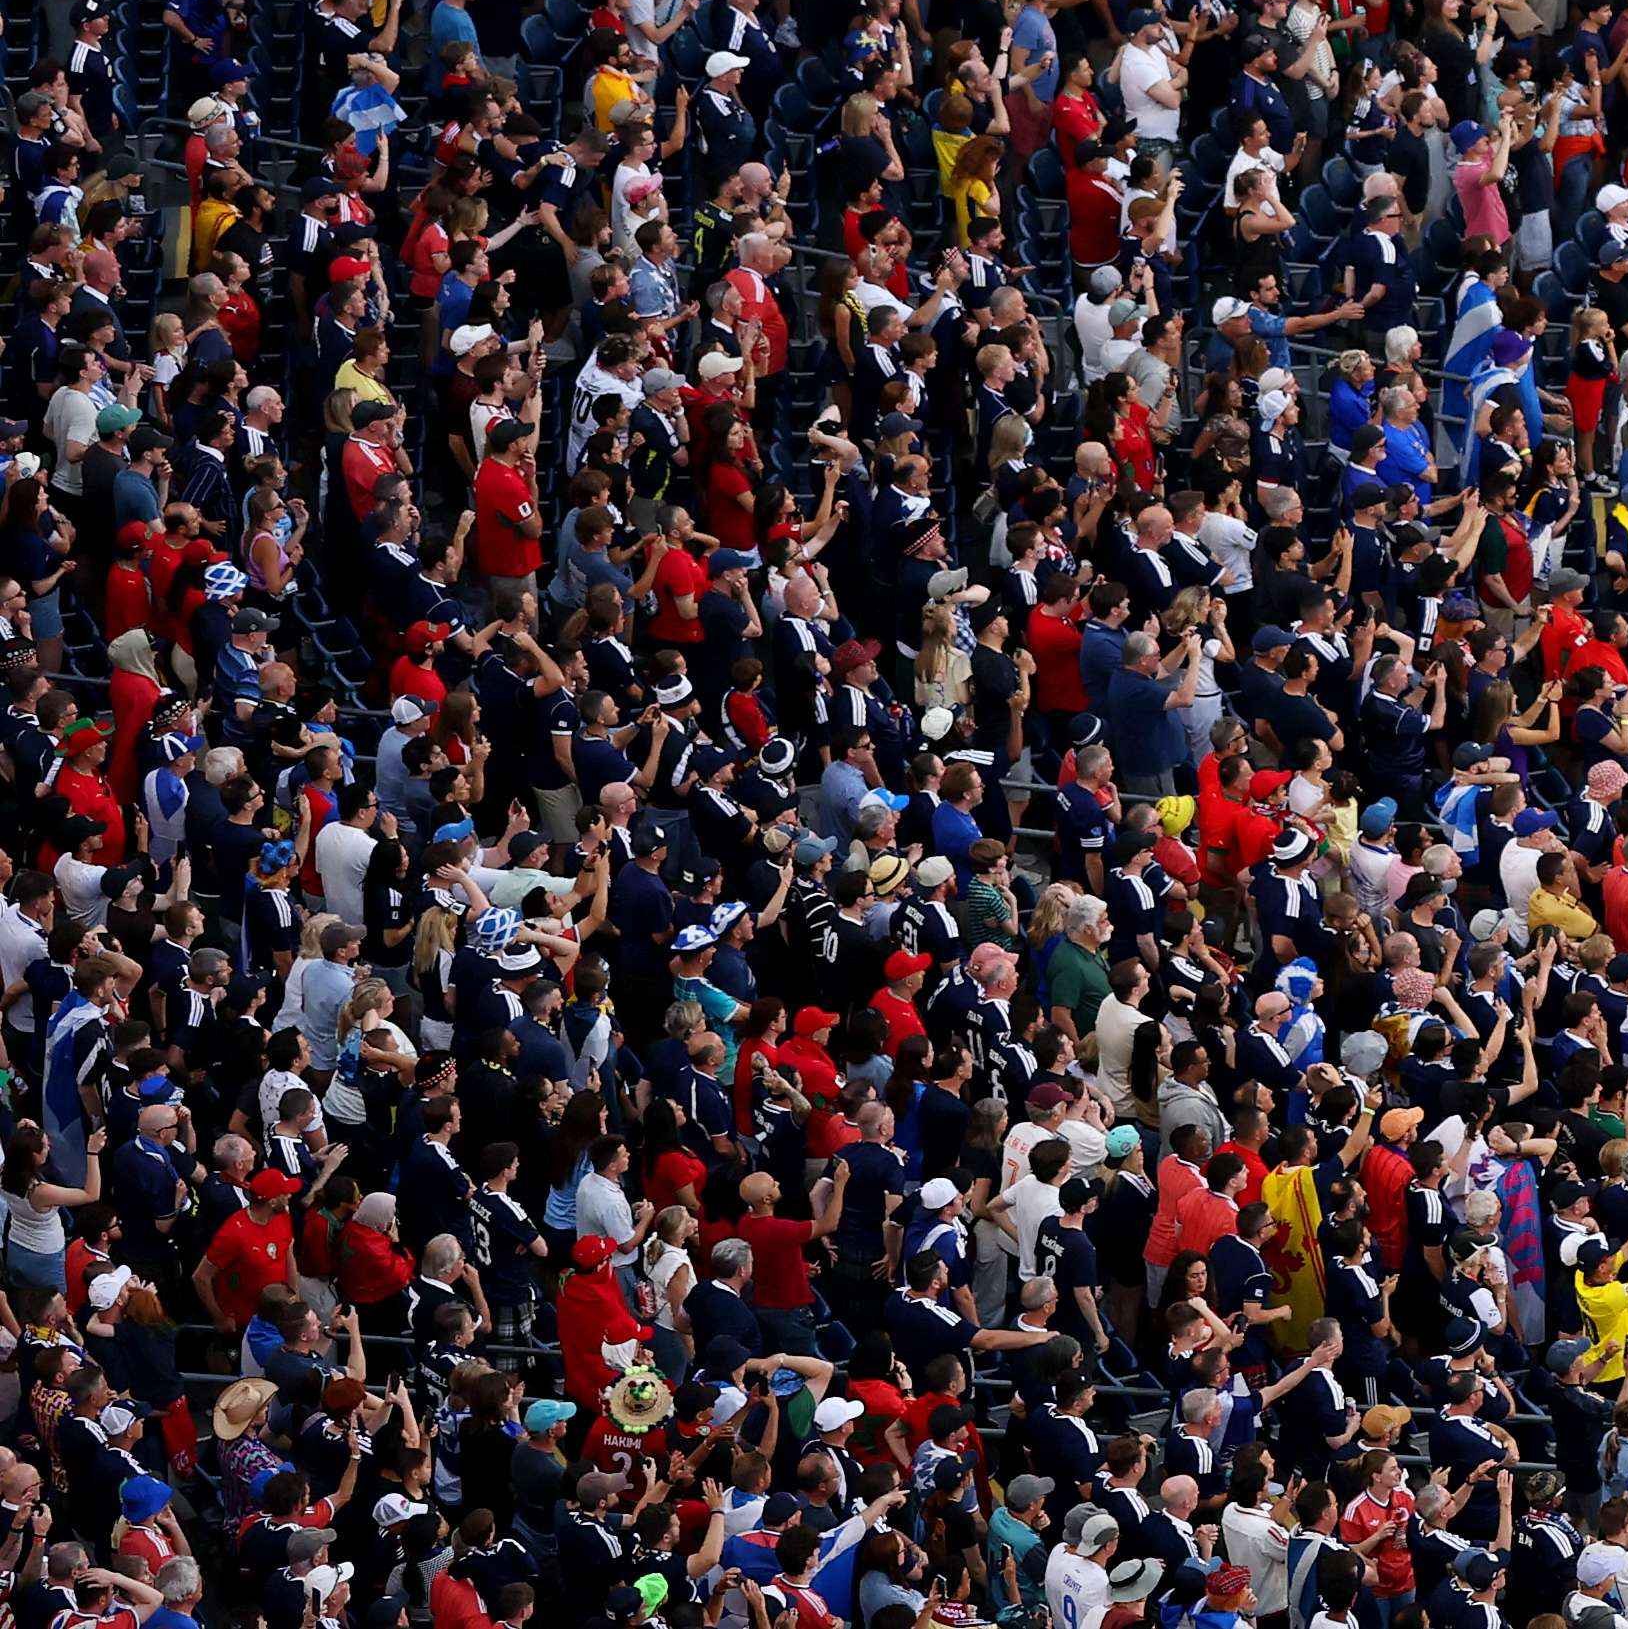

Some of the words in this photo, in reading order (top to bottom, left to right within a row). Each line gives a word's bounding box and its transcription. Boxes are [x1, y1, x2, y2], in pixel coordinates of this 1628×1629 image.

[824, 925, 839, 963] 10
[604, 1433, 643, 1454] HAKIMI
[613, 1451, 636, 1490] 2
